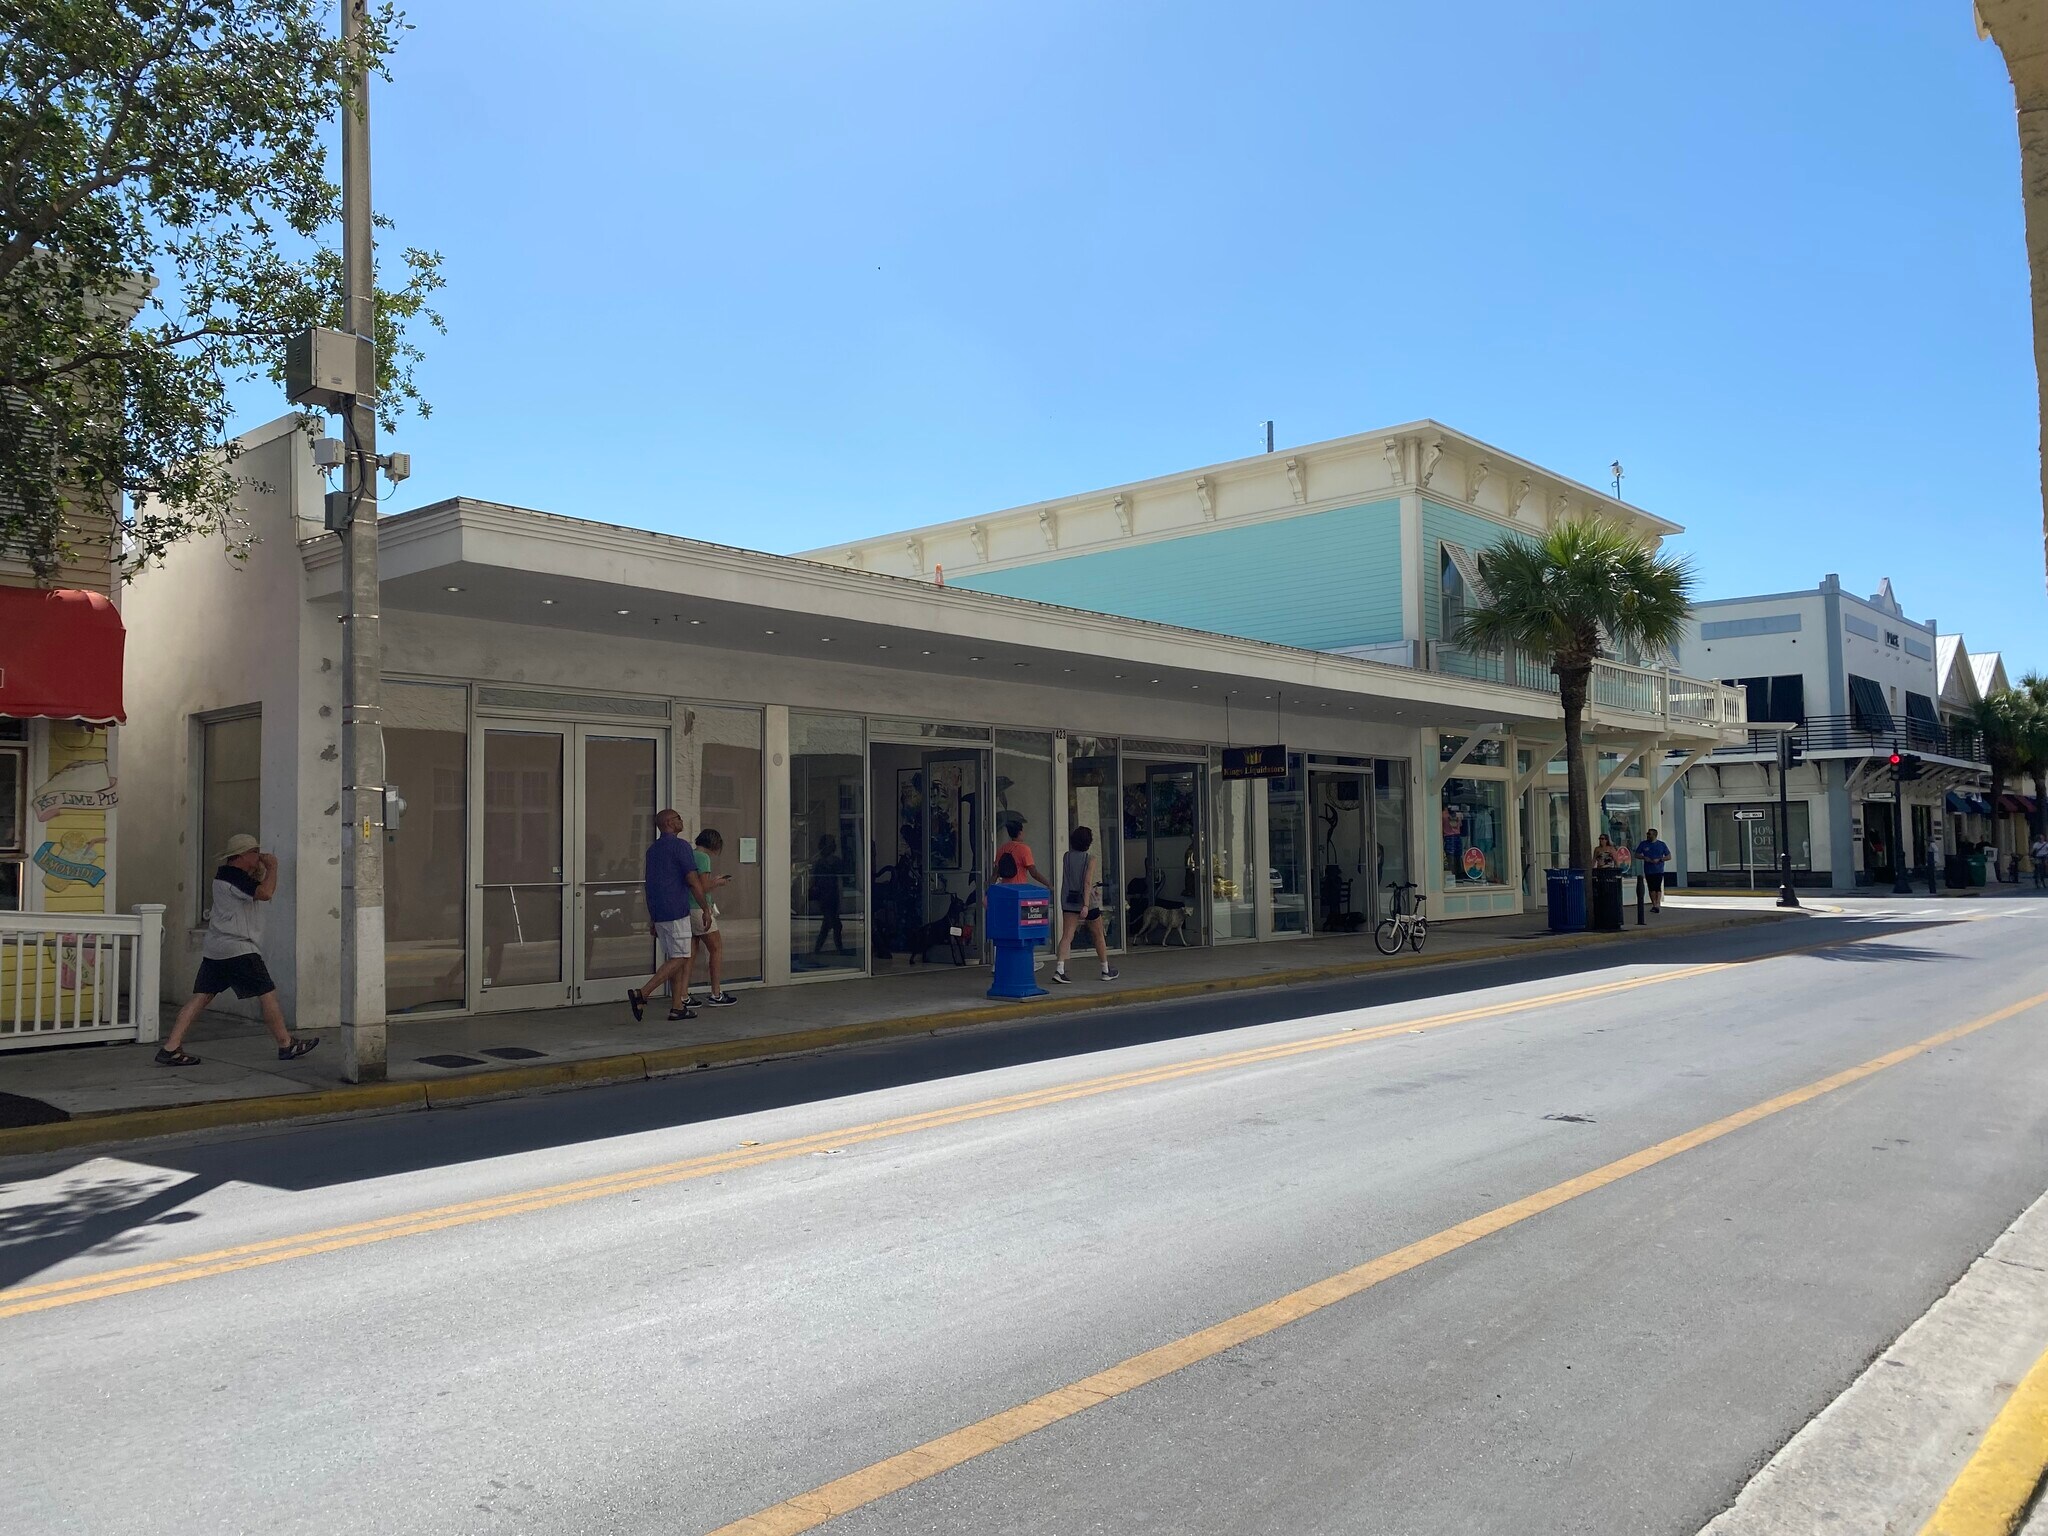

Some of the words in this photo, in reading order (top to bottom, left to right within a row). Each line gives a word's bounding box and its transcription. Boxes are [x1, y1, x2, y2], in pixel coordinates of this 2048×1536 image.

[1055, 730, 1066, 739] 423
[1244, 765, 1285, 776] Liquidators
[37, 794, 57, 811] KEY
[98, 791, 119, 806] PIE
[1753, 836, 1773, 846] OFF
[41, 851, 99, 880] LEMONADE
